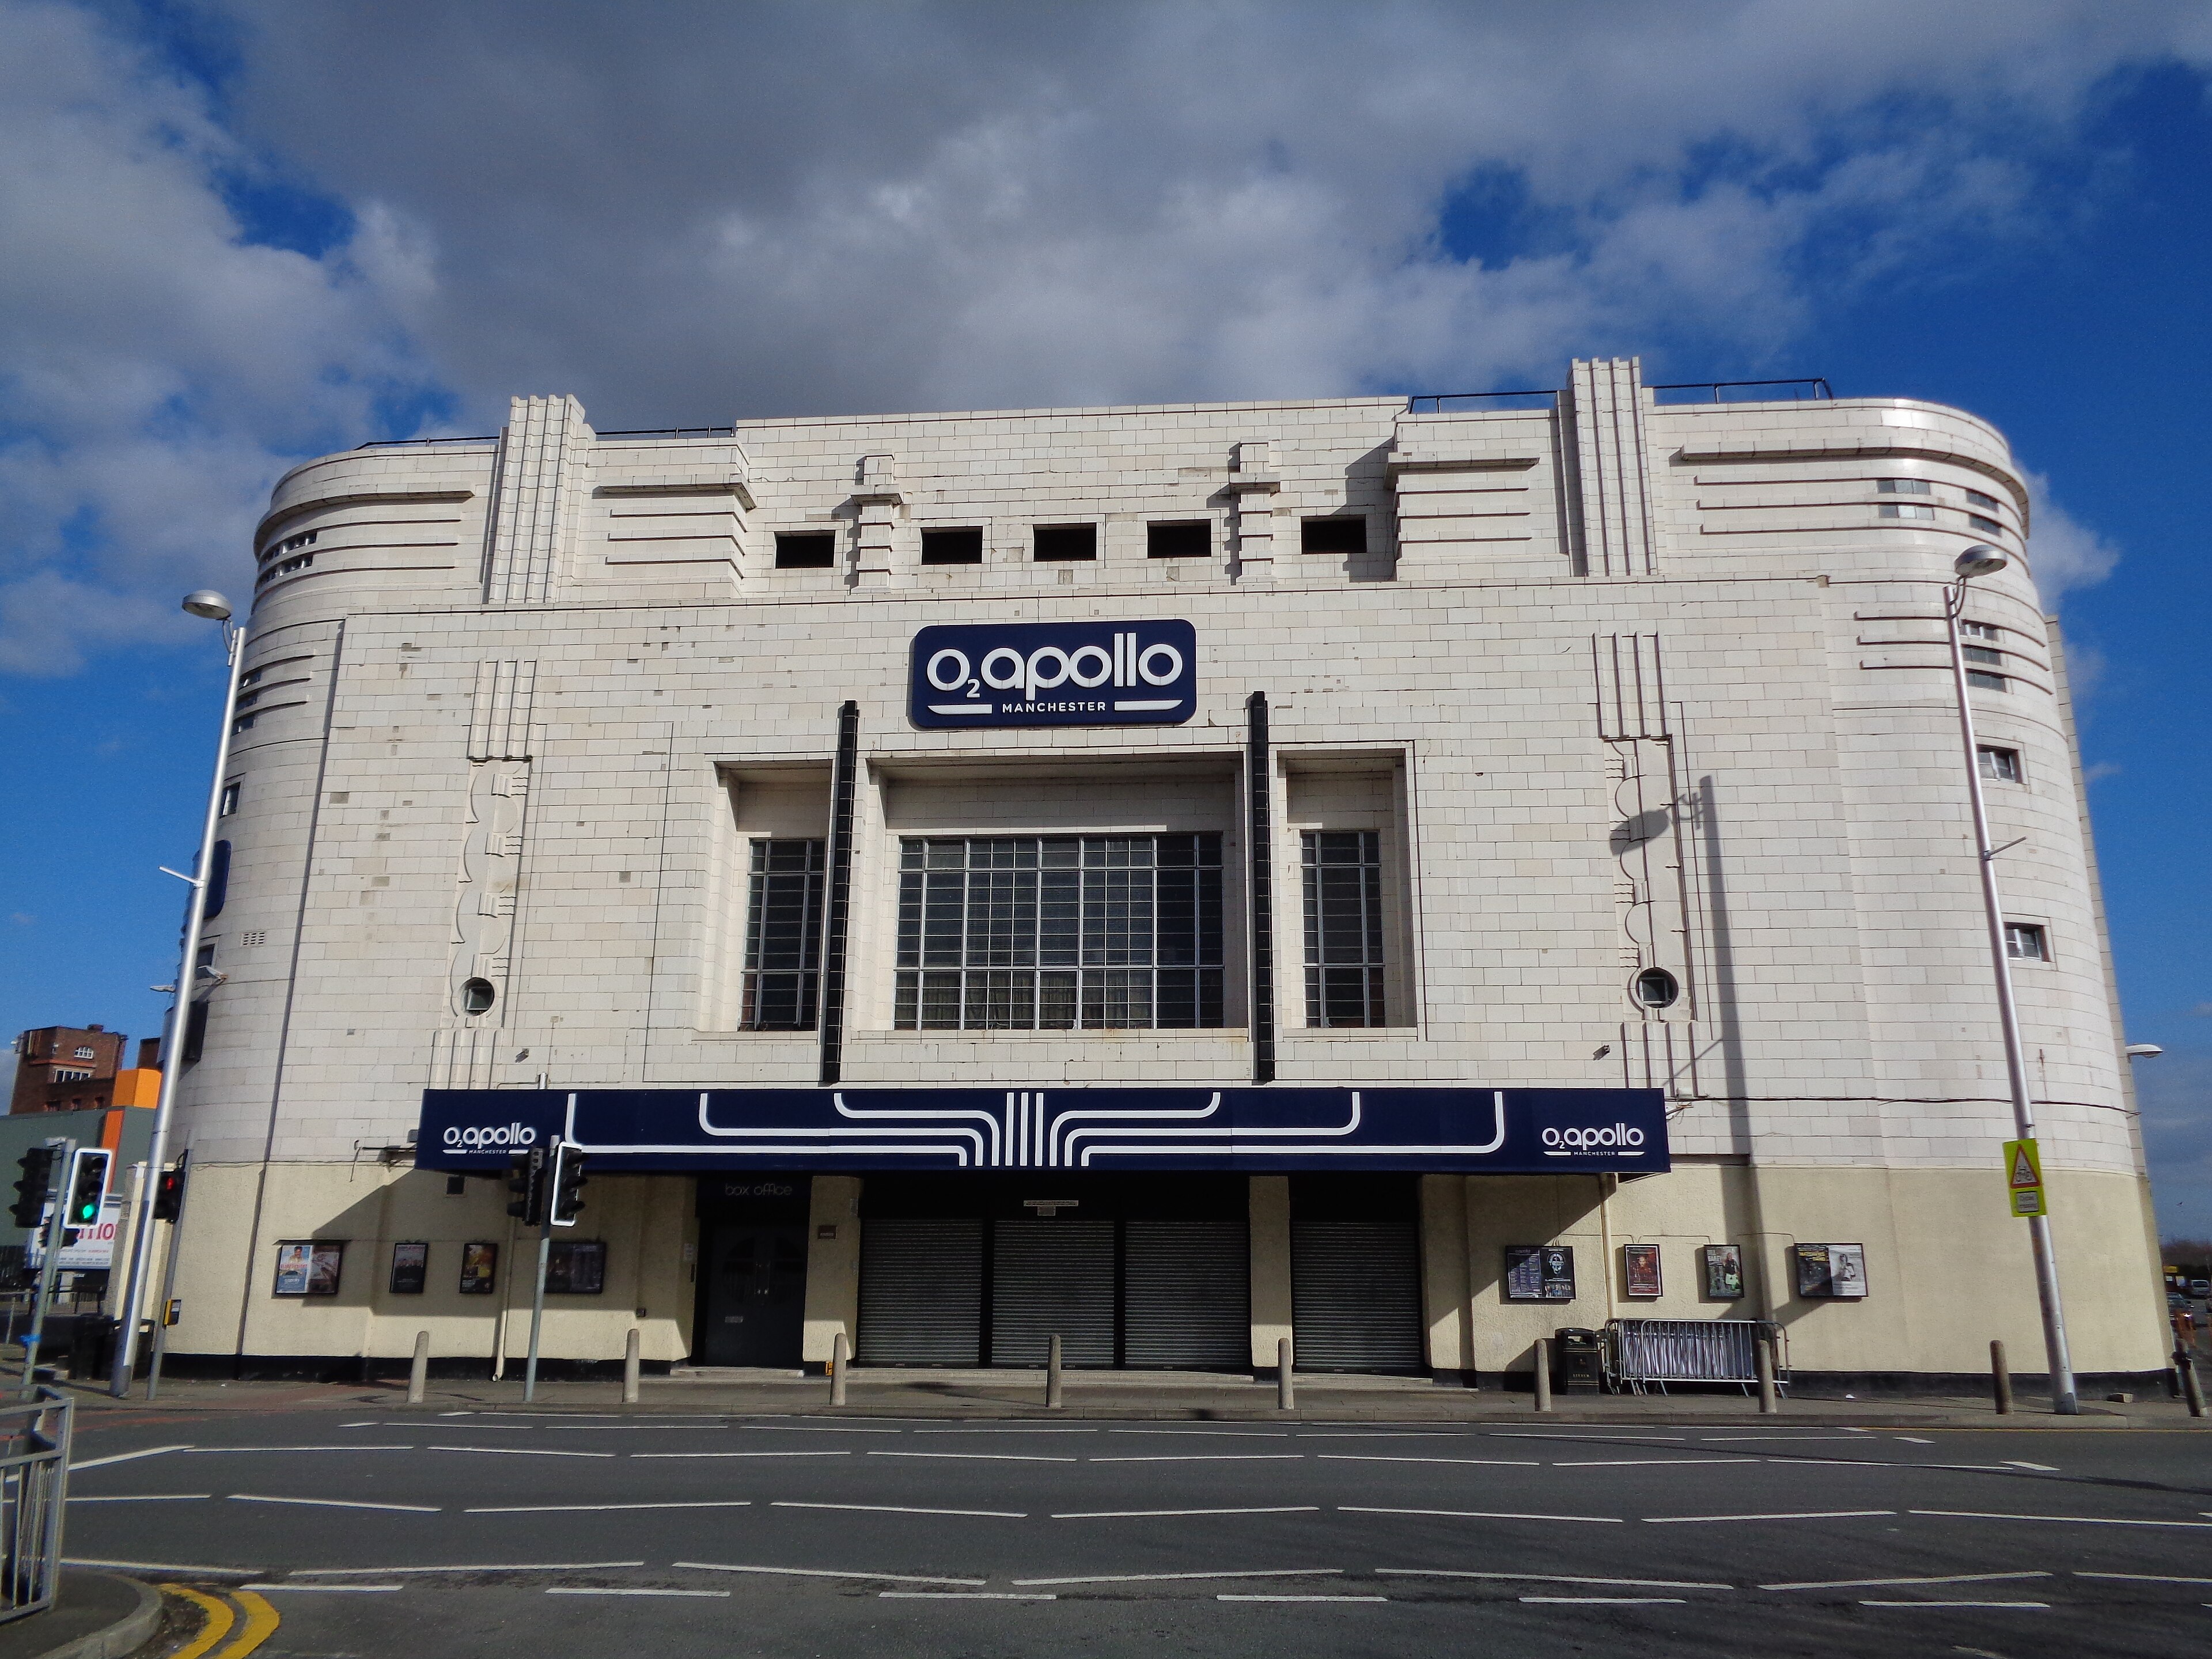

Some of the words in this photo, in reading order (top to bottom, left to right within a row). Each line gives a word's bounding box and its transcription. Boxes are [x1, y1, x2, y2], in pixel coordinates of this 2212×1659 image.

[1002, 702, 1106, 713] MANCHESTER
[725, 1183, 750, 1196] box
[753, 1183, 793, 1196] office
